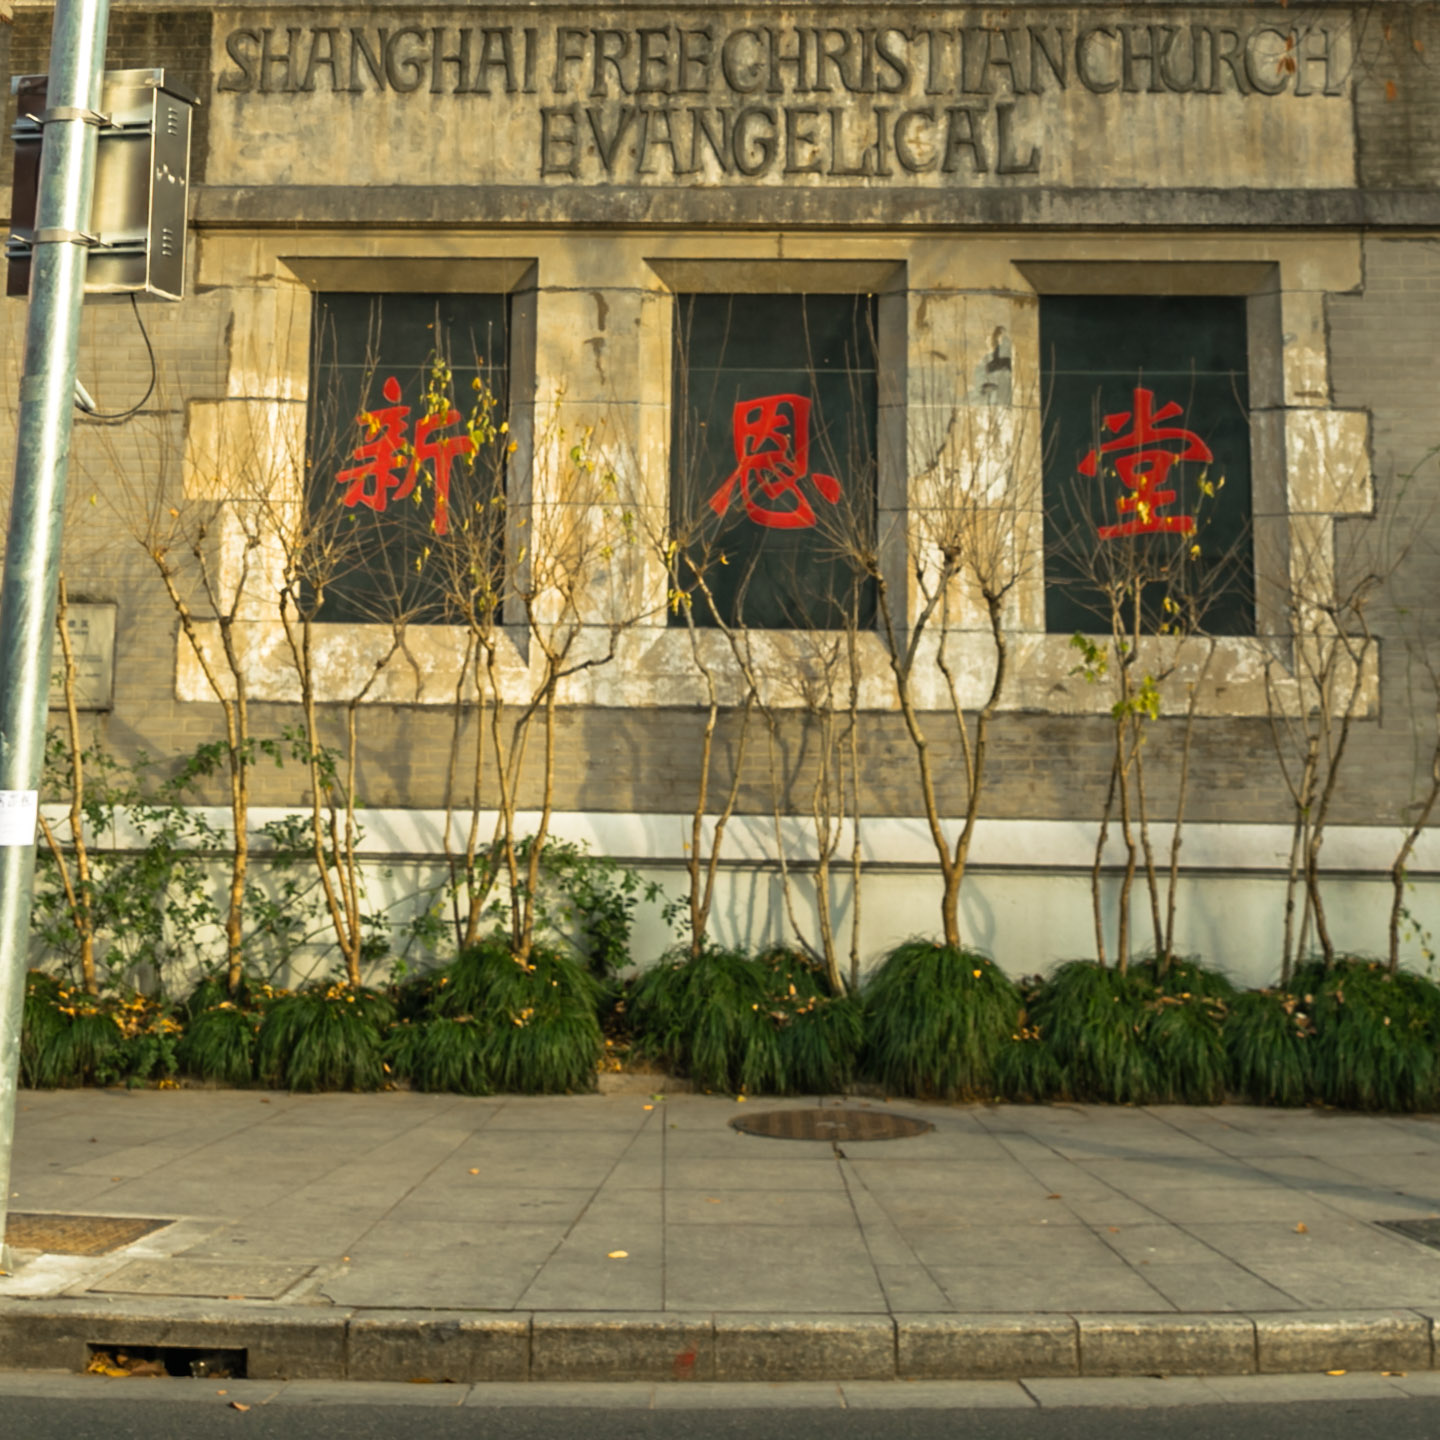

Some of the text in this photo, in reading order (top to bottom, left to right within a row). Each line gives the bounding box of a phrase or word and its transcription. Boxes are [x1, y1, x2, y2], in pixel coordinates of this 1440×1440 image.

[216, 23, 1343, 98] SHANGHAI FREE CHRISTIAN CHURCH
[540, 104, 1039, 179] EVANGELICAL
